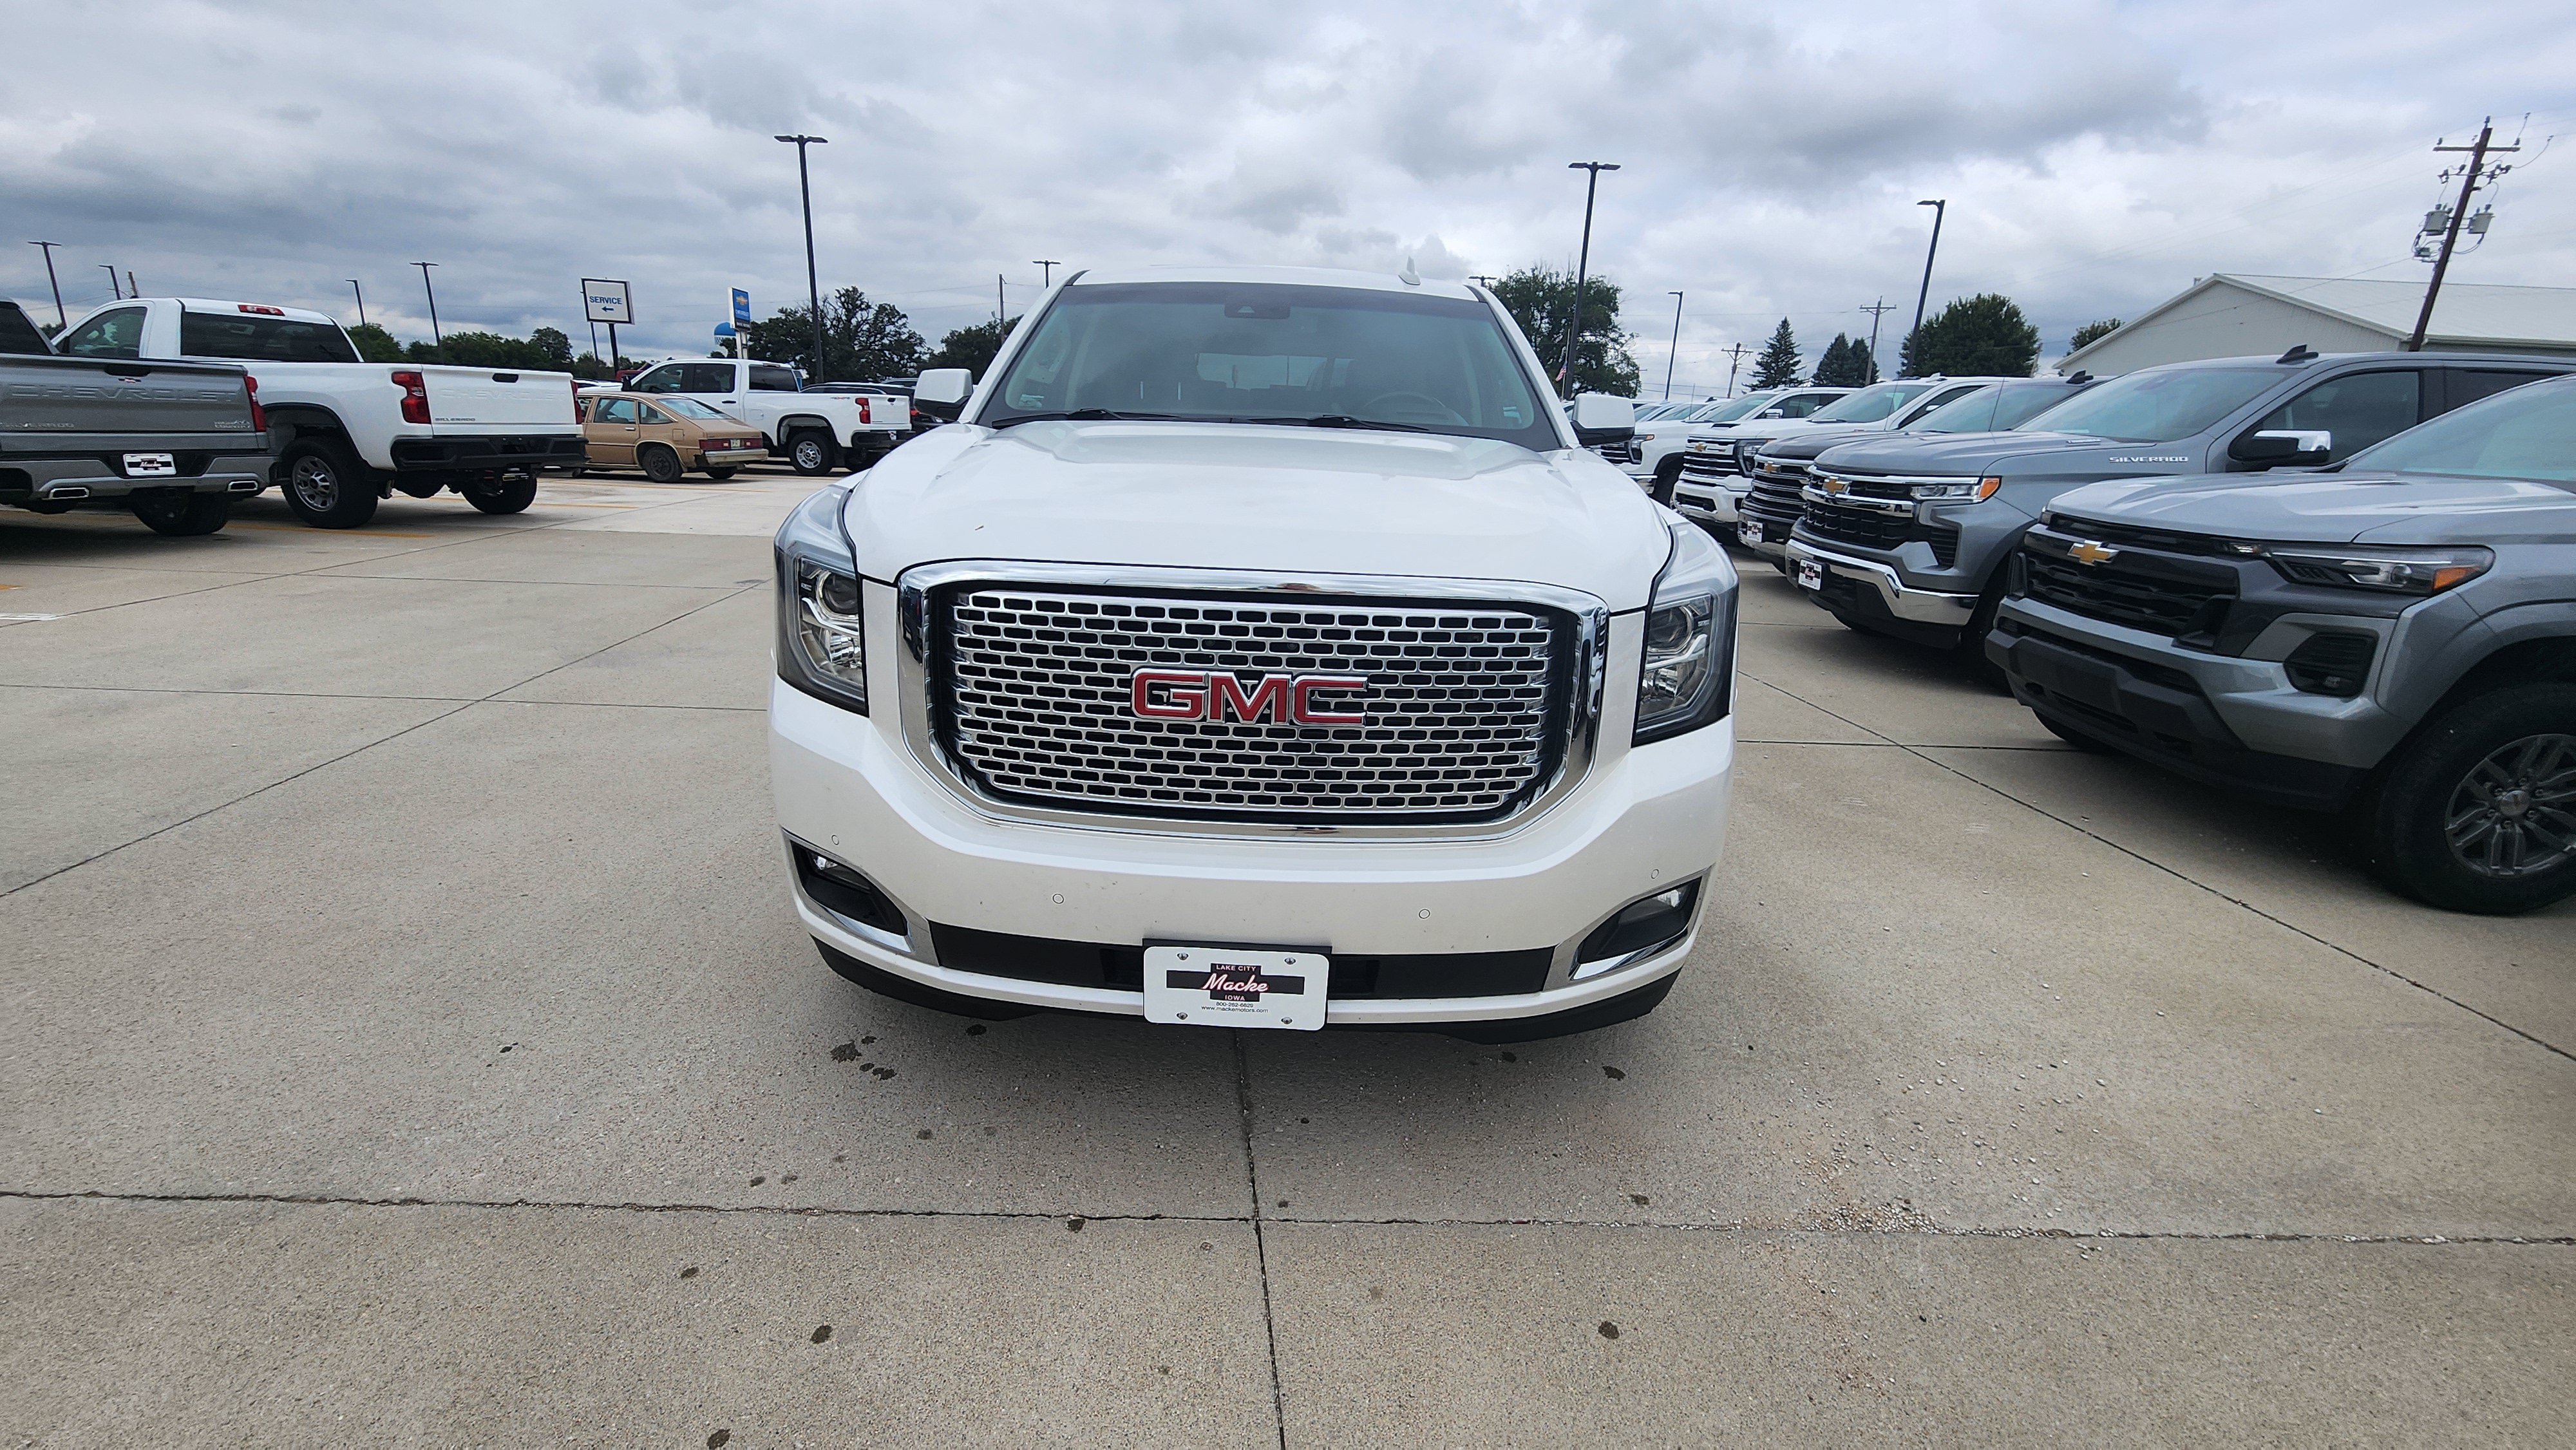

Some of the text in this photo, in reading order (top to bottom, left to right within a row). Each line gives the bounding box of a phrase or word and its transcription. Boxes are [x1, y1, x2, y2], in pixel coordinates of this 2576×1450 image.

[589, 296, 622, 305] SERVICE
[10, 384, 238, 402] CHEVROLET
[1130, 668, 1368, 727] GMC
[1201, 973, 1269, 992] Macke
